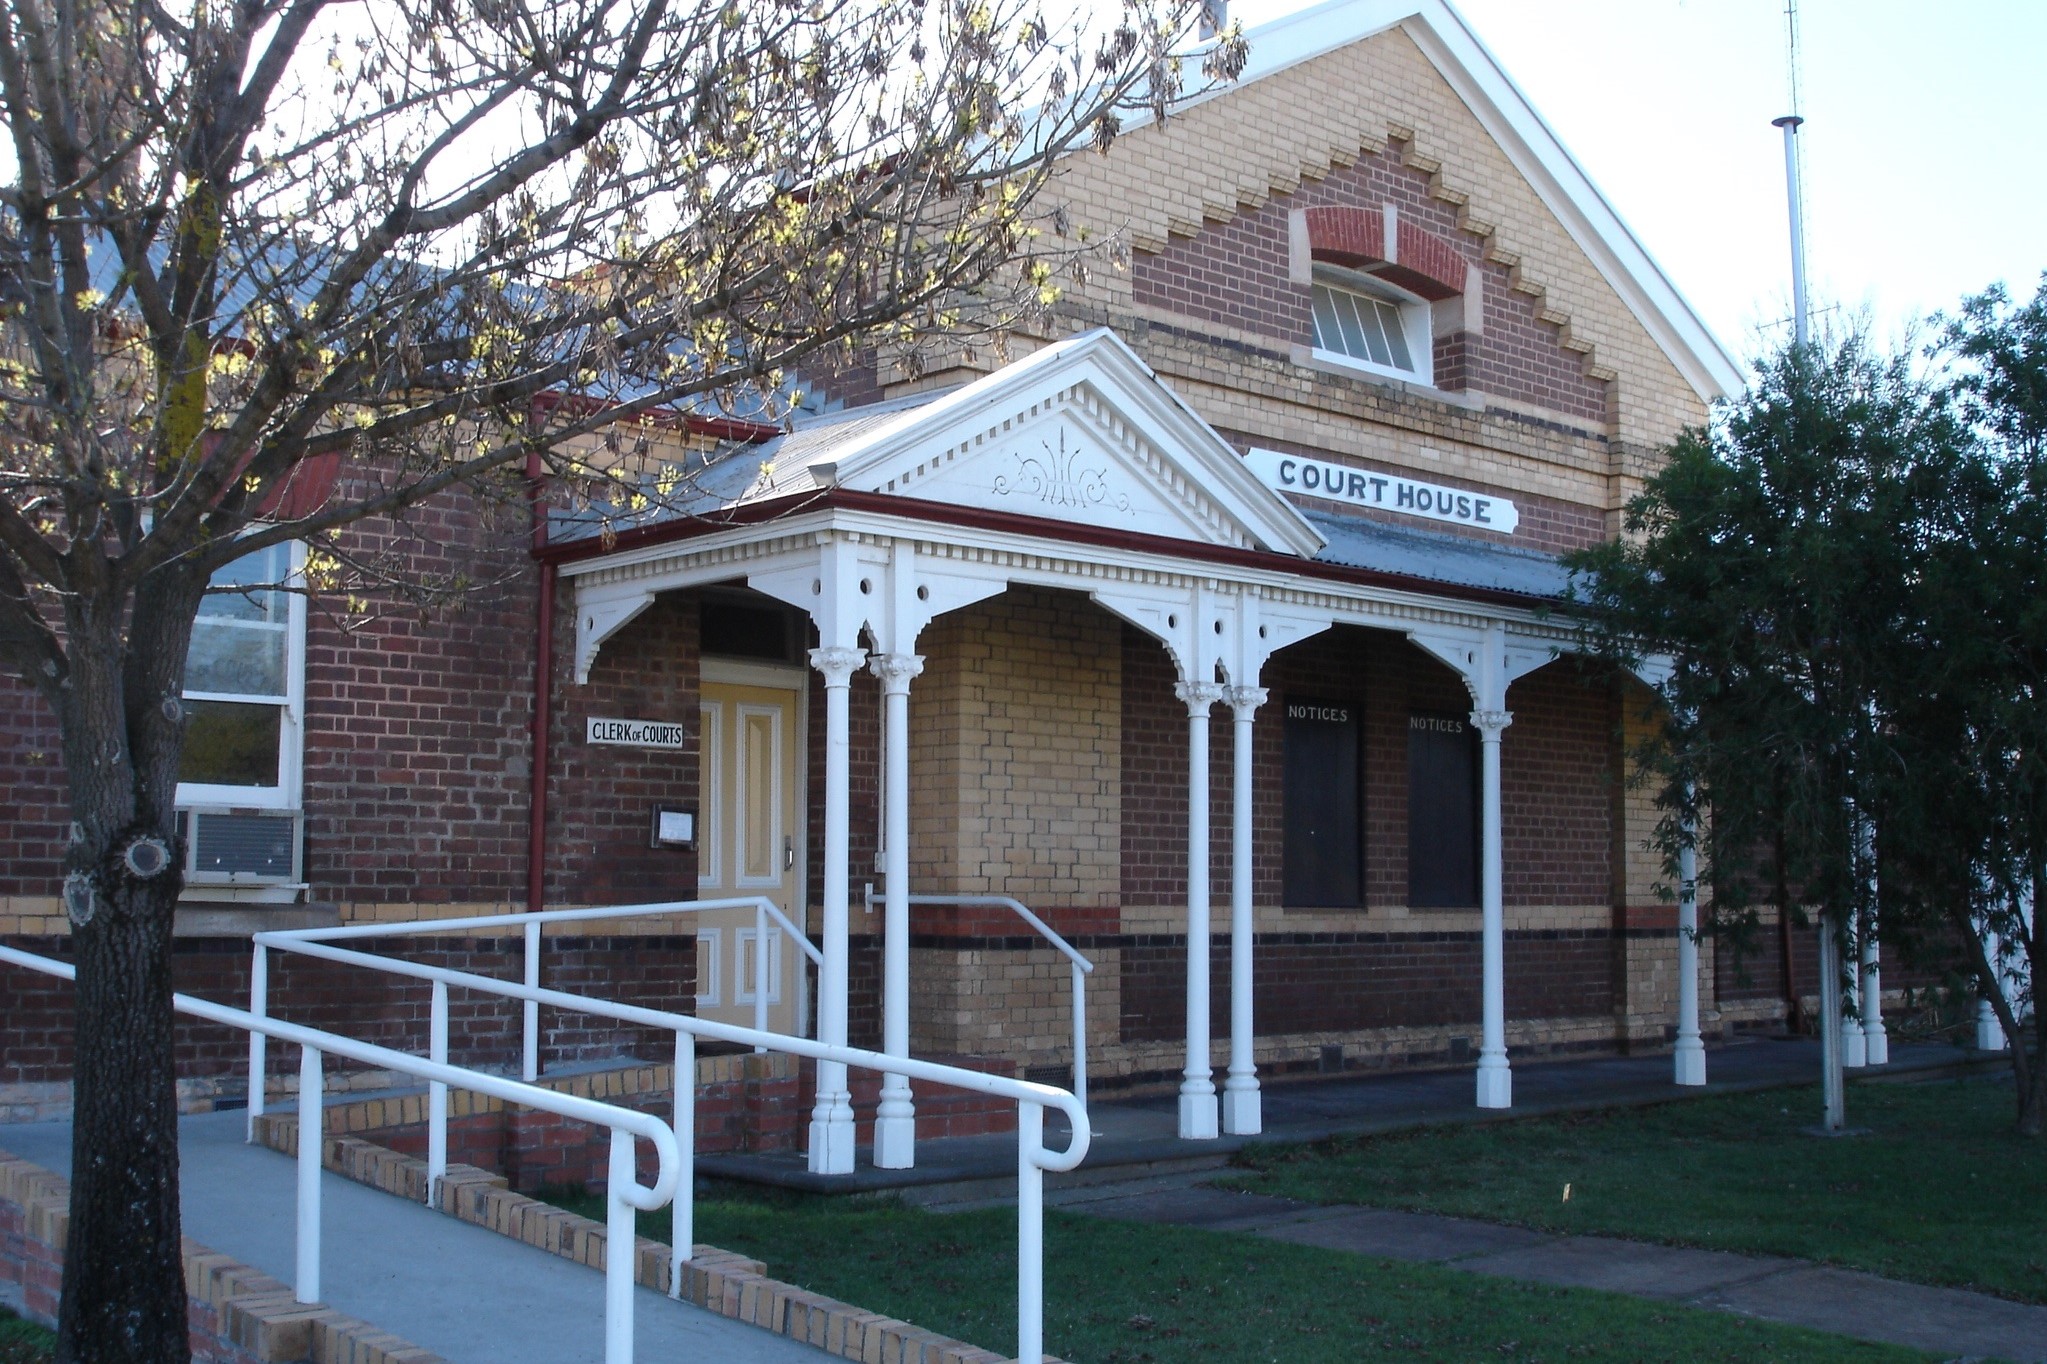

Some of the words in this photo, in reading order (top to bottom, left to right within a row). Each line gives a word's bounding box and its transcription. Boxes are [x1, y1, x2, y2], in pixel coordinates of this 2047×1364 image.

[1279, 459, 1388, 502] COURT
[1397, 483, 1491, 523] HOUSE
[1288, 705, 1348, 722] NOTICES
[593, 722, 631, 741] CLERK
[632, 731, 641, 741] OF
[642, 725, 681, 744] COURTS
[1410, 716, 1462, 733] NOTICES
